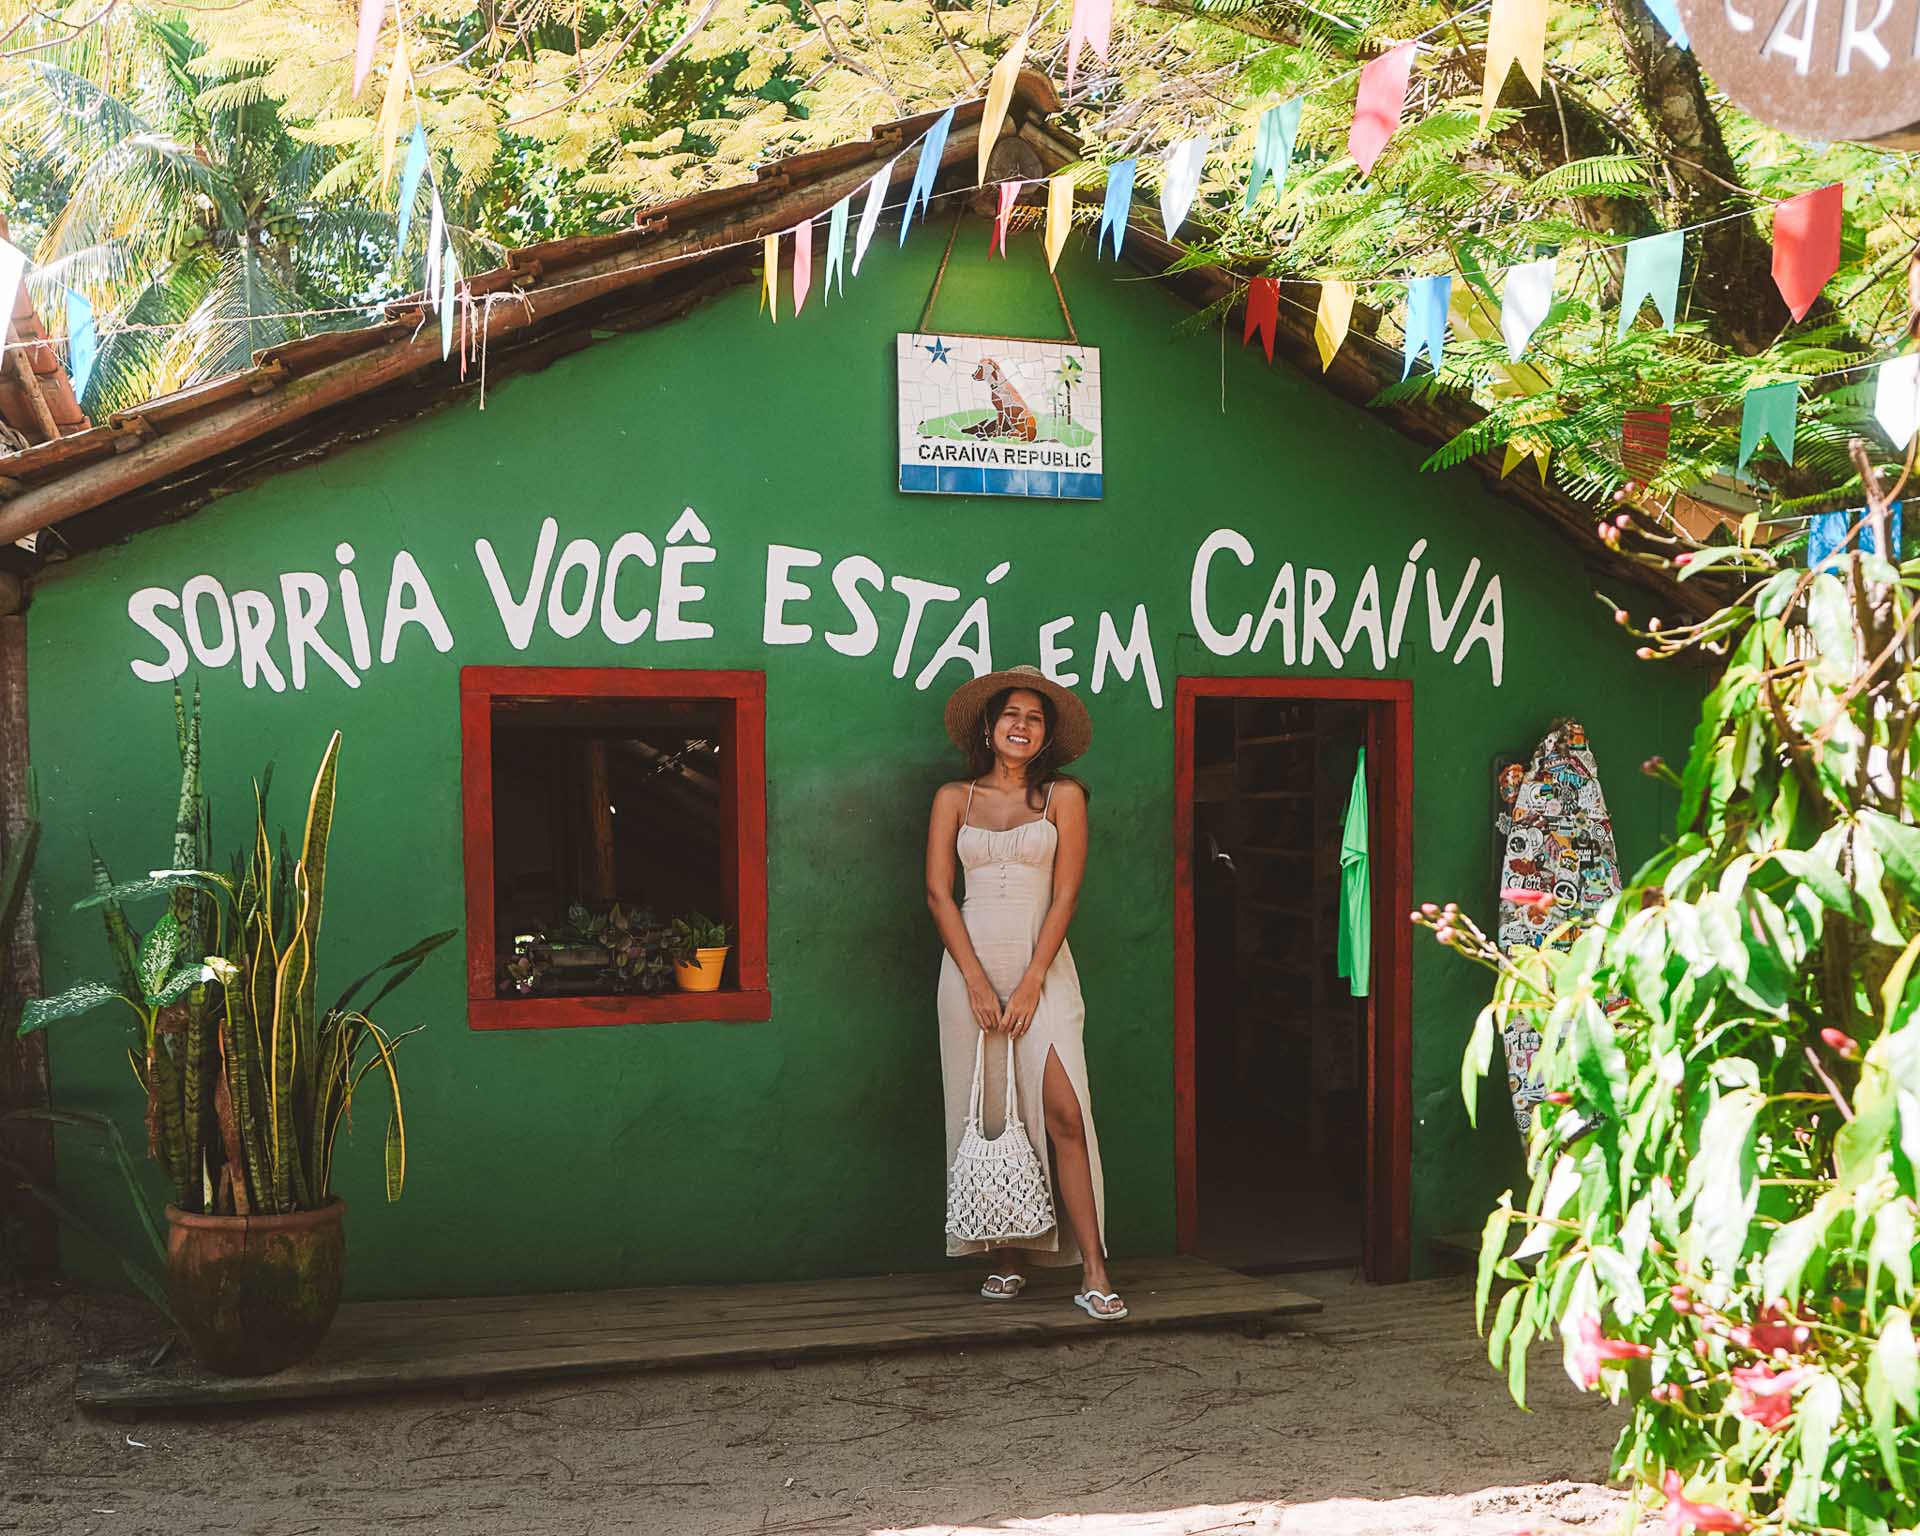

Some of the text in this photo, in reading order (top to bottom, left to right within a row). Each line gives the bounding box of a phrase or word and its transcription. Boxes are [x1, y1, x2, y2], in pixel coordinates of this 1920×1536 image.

[918, 443, 1092, 468] CARAÍVA REPUBLIC
[128, 506, 1504, 709] SORRIA VOCÊ ESTÁ EM CARAÍVA
